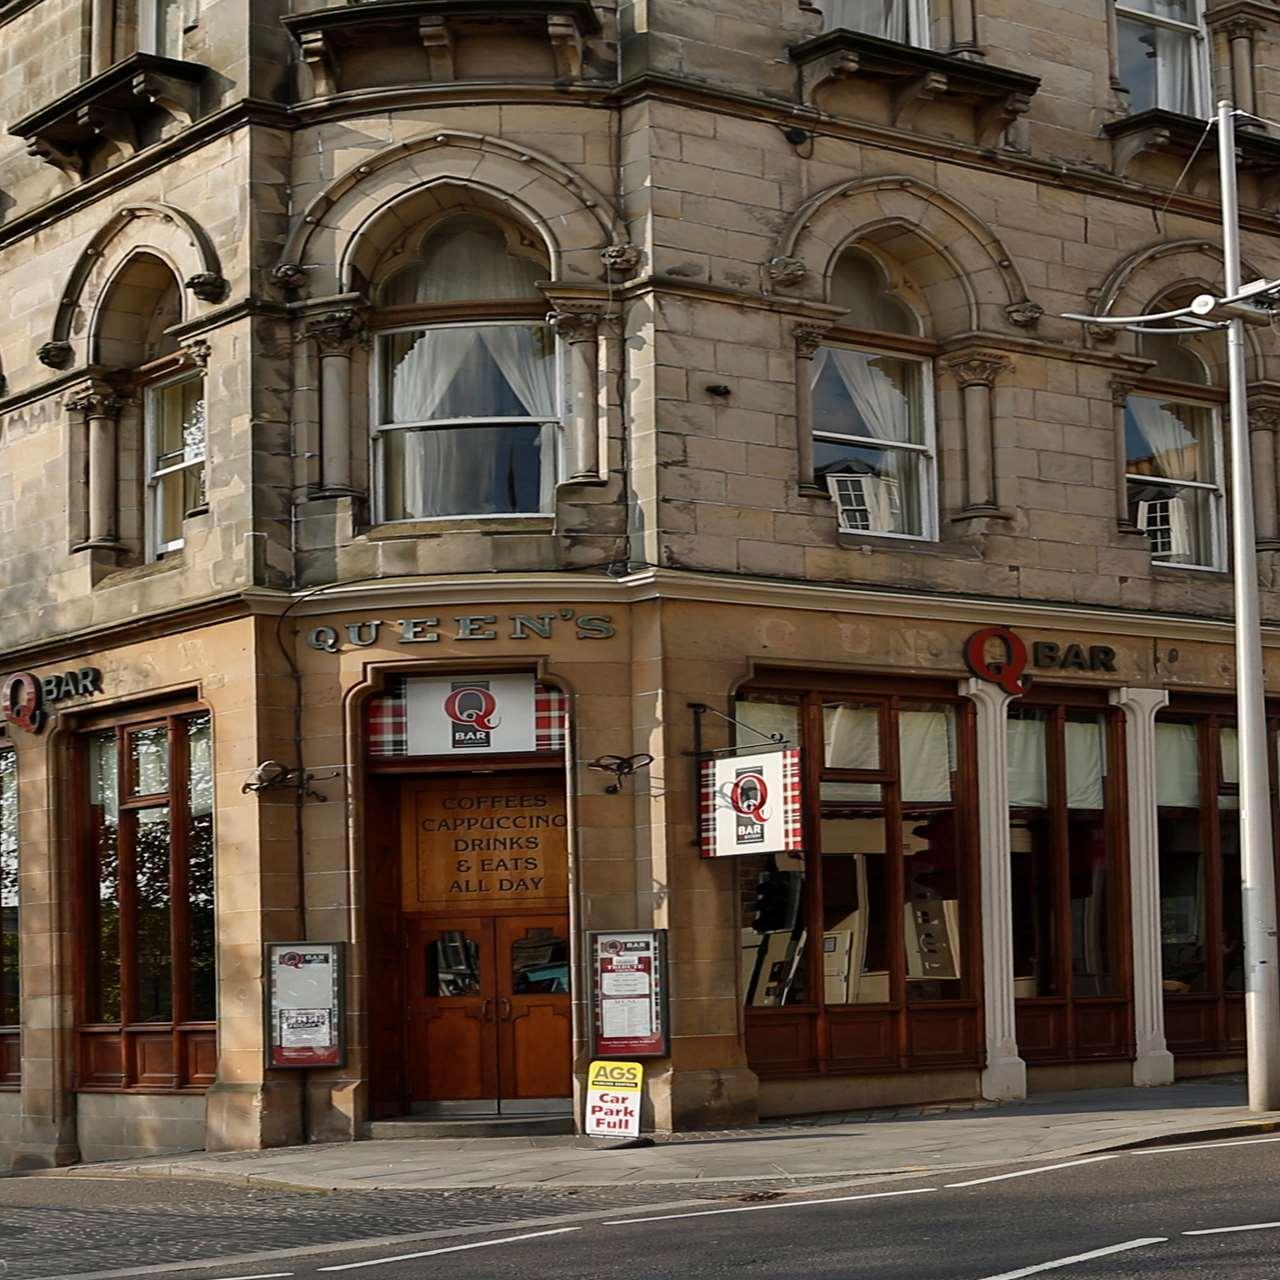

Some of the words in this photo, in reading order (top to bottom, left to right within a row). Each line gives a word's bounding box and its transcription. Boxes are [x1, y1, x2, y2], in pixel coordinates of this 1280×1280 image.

[306, 608, 616, 653] QUEEN'S
[963, 626, 1031, 696] Q
[1033, 641, 1118, 671] BAR
[1, 672, 46, 734] Q
[41, 667, 103, 701] BAR
[445, 687, 501, 731] Q
[455, 731, 487, 741] BAR
[442, 794, 546, 810] COFFEES
[730, 772, 772, 824] Q
[422, 815, 567, 832] CAPPUCCINO
[738, 825, 761, 835] BAR
[453, 836, 539, 852] DRINKS
[455, 859, 472, 873] &
[480, 857, 538, 872] EATS
[448, 880, 490, 893] ALL
[498, 877, 544, 892] DAY
[594, 1066, 637, 1080] AGS
[599, 1093, 629, 1104] Car
[591, 1105, 634, 1117] Park
[596, 1118, 629, 1129] Full
